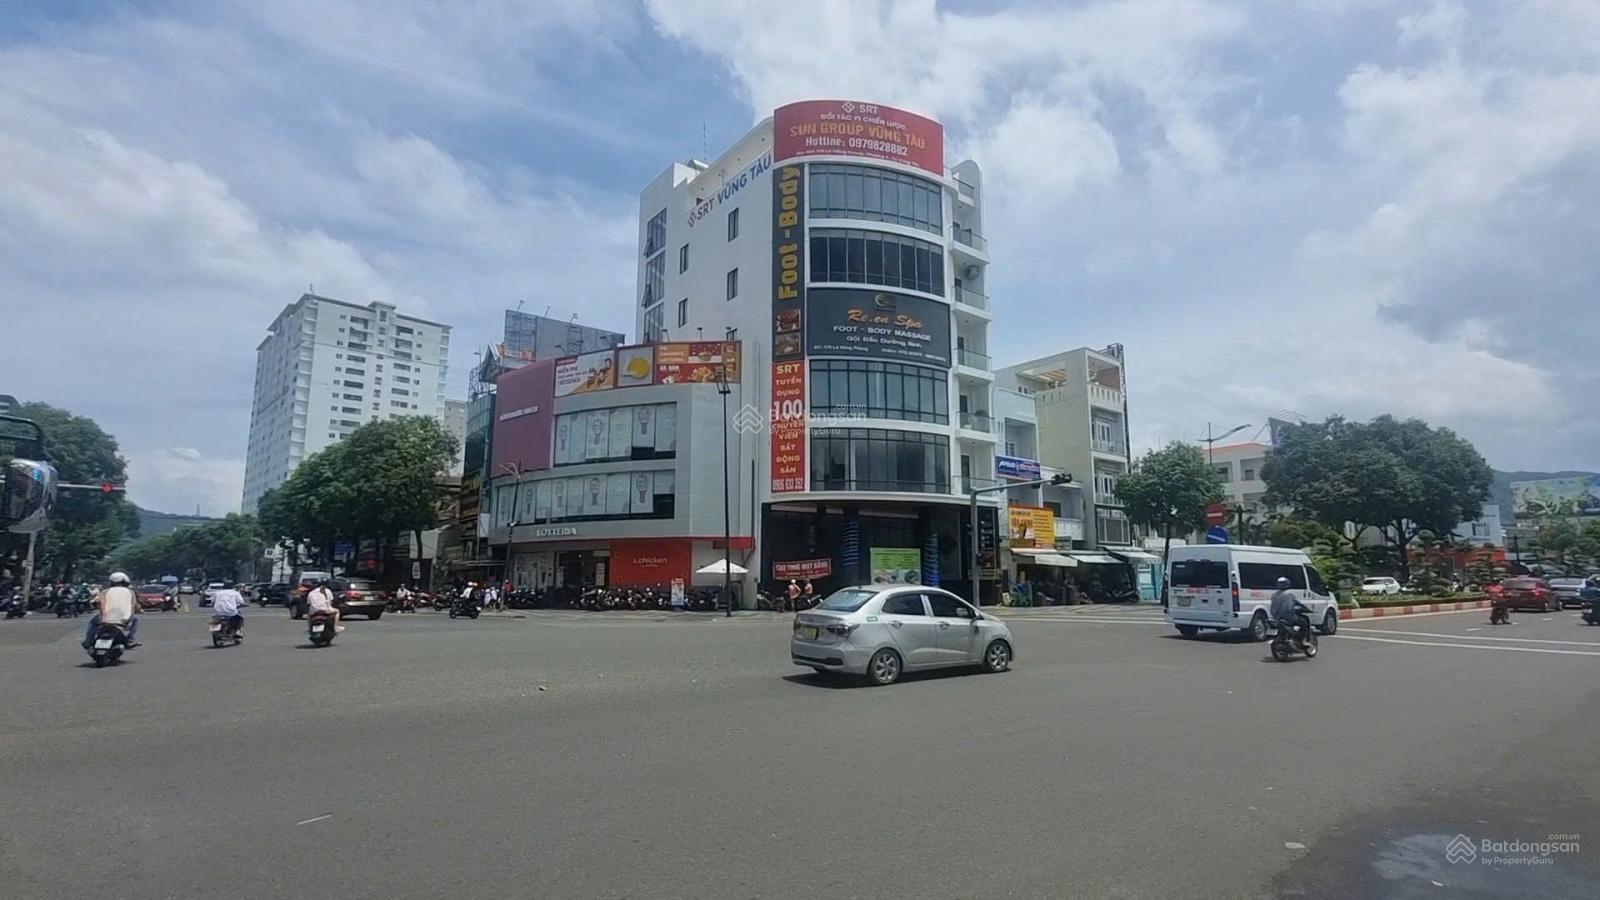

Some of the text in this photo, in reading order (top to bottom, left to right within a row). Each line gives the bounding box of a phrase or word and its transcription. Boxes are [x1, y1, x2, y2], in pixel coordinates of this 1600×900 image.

[859, 104, 879, 115] SRT
[790, 122, 926, 149] SUN GROUP VŨNG TÀU
[805, 136, 846, 147] Hotline:
[697, 198, 715, 221] SRT
[717, 173, 748, 204] VŨNG
[750, 154, 772, 181] TÀU
[778, 165, 801, 228] Body
[778, 243, 798, 300] Foot
[894, 315, 923, 330] Spa
[833, 325, 858, 333] FOOT
[867, 327, 892, 335] BODY
[894, 329, 932, 341] MASSAGE
[776, 363, 801, 374] SRT
[776, 388, 800, 398] DỤNG
[773, 399, 803, 420] 100
[780, 441, 796, 451] BẤT
[776, 454, 800, 464] ĐỘNG
[536, 527, 577, 537] LOTTERIA
